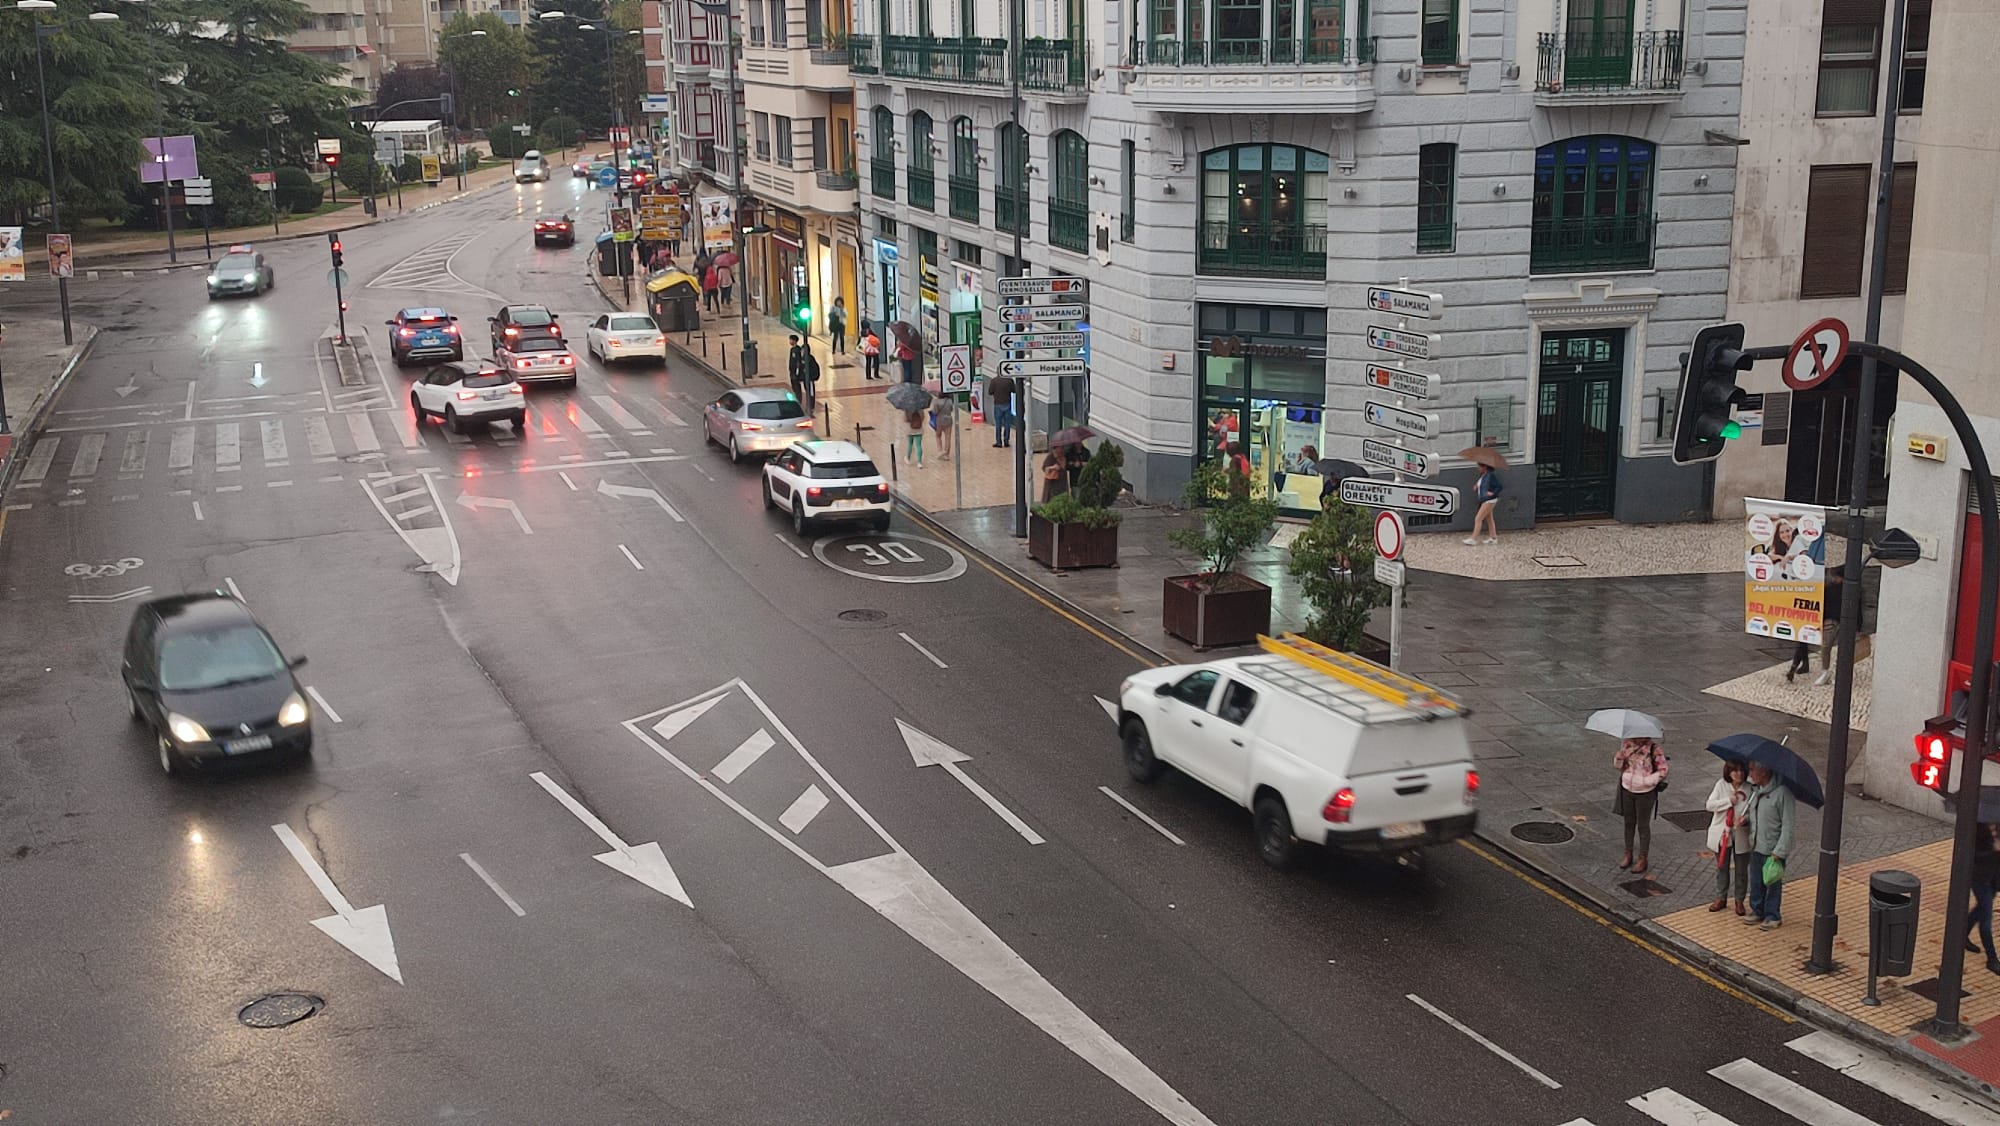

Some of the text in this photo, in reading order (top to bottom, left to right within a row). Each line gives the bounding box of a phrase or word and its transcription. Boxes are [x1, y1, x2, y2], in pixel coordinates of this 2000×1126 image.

[1394, 298, 1429, 311] SALAMANCA
[1035, 308, 1082, 317] SALAMANCA
[1040, 364, 1082, 372] Hospitales
[1395, 416, 1426, 432] Hospitales
[1345, 483, 1392, 495] BENAVENTE
[1344, 491, 1385, 503] ORENSE
[1408, 494, 1434, 505] N-630
[845, 542, 925, 566] 30
[1749, 602, 1766, 614] DEL
[1793, 598, 1820, 612] FERIA
